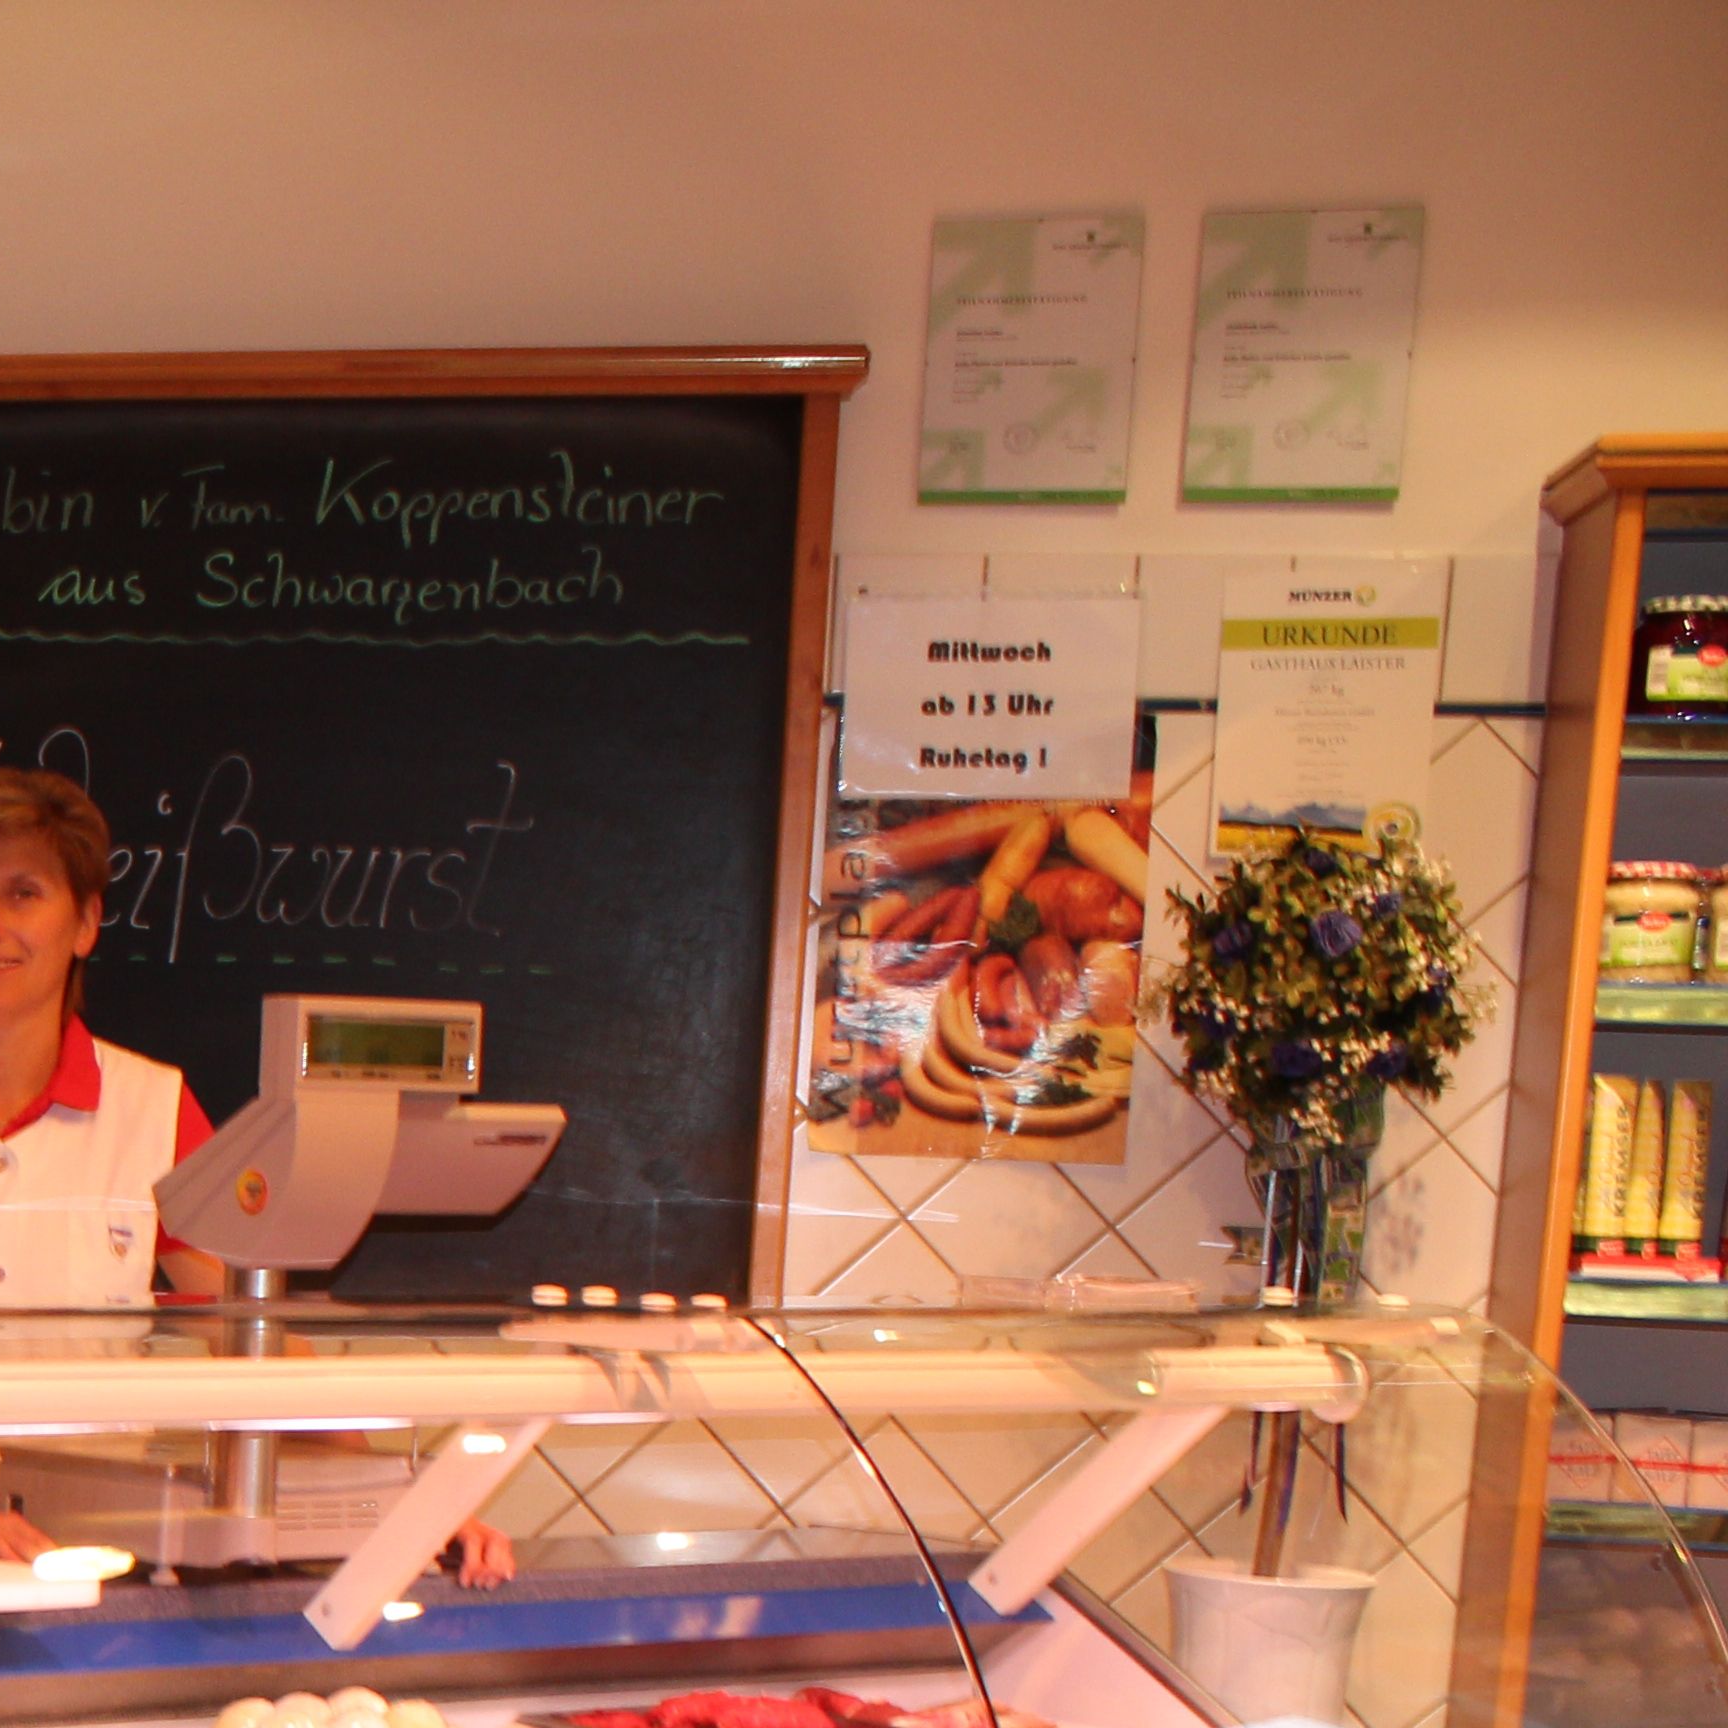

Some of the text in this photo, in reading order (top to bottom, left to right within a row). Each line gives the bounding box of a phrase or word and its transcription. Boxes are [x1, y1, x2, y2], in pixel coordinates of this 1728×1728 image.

[315, 450, 724, 548] Koppensteiner
[40, 567, 146, 608] aus
[1262, 624, 1398, 647] URKUNDE
[928, 641, 1051, 662] Mittwoch
[921, 694, 1054, 716] ab 13 Uhr
[919, 747, 1028, 774] Ruhetag
